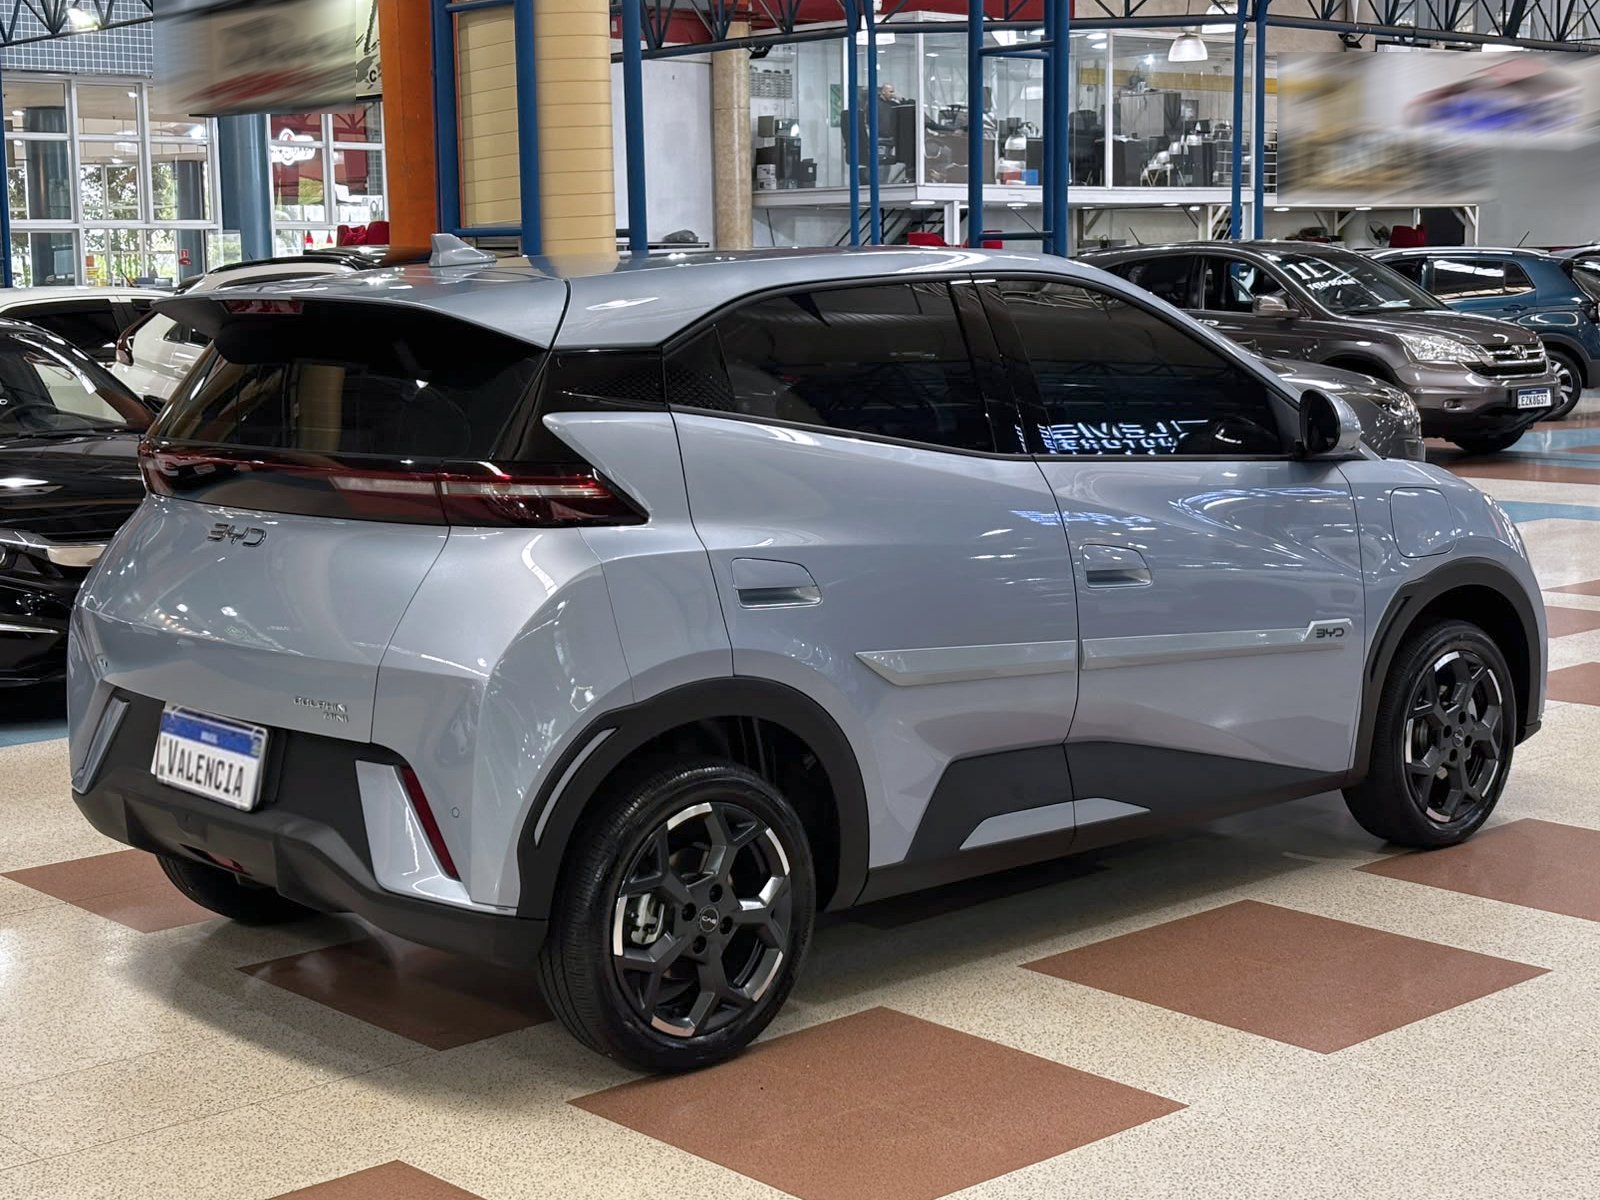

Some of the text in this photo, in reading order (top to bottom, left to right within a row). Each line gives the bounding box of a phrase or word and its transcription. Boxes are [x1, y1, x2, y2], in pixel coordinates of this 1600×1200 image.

[207, 522, 267, 548] BYD
[1316, 627, 1345, 638] BYD
[167, 738, 244, 798] VALENCIA
